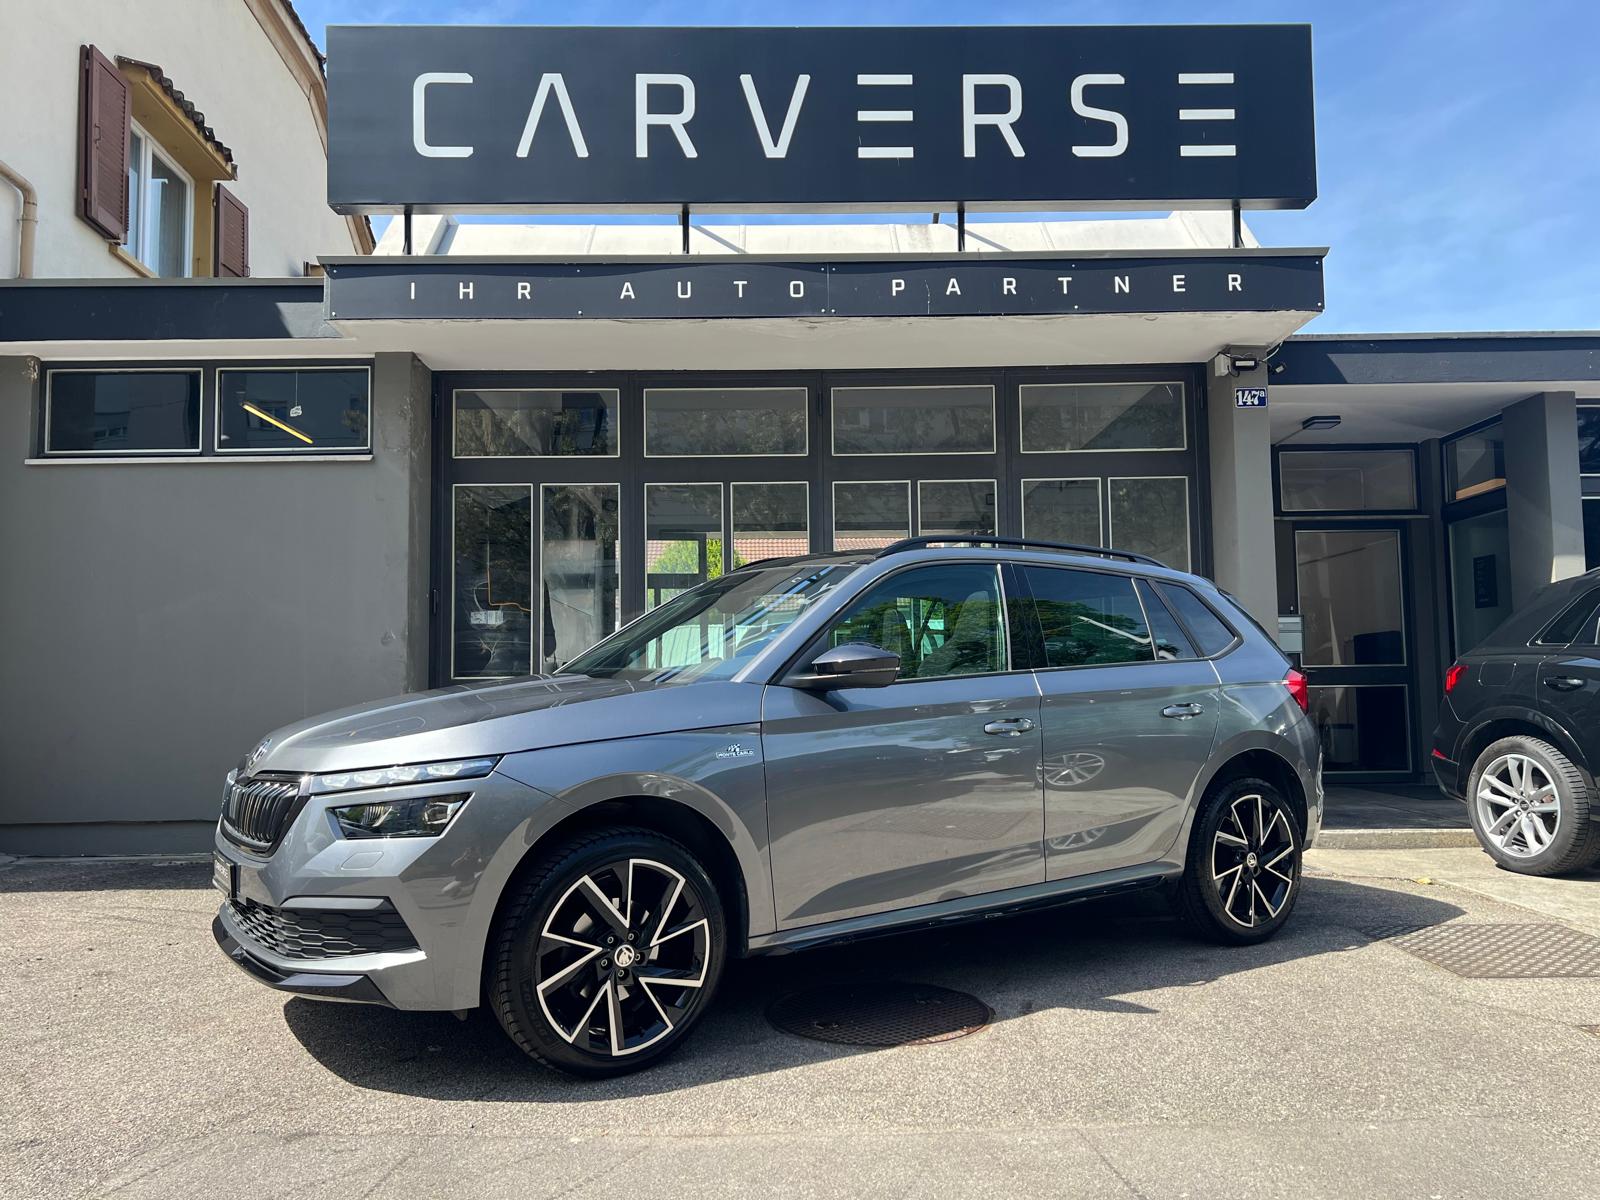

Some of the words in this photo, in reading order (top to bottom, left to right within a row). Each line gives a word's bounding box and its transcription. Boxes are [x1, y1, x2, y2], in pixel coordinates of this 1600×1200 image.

[412, 72, 1237, 159] CARVERSE
[408, 281, 532, 300] IHR
[620, 281, 805, 299] AUTO
[891, 274, 1243, 296] PARTNER
